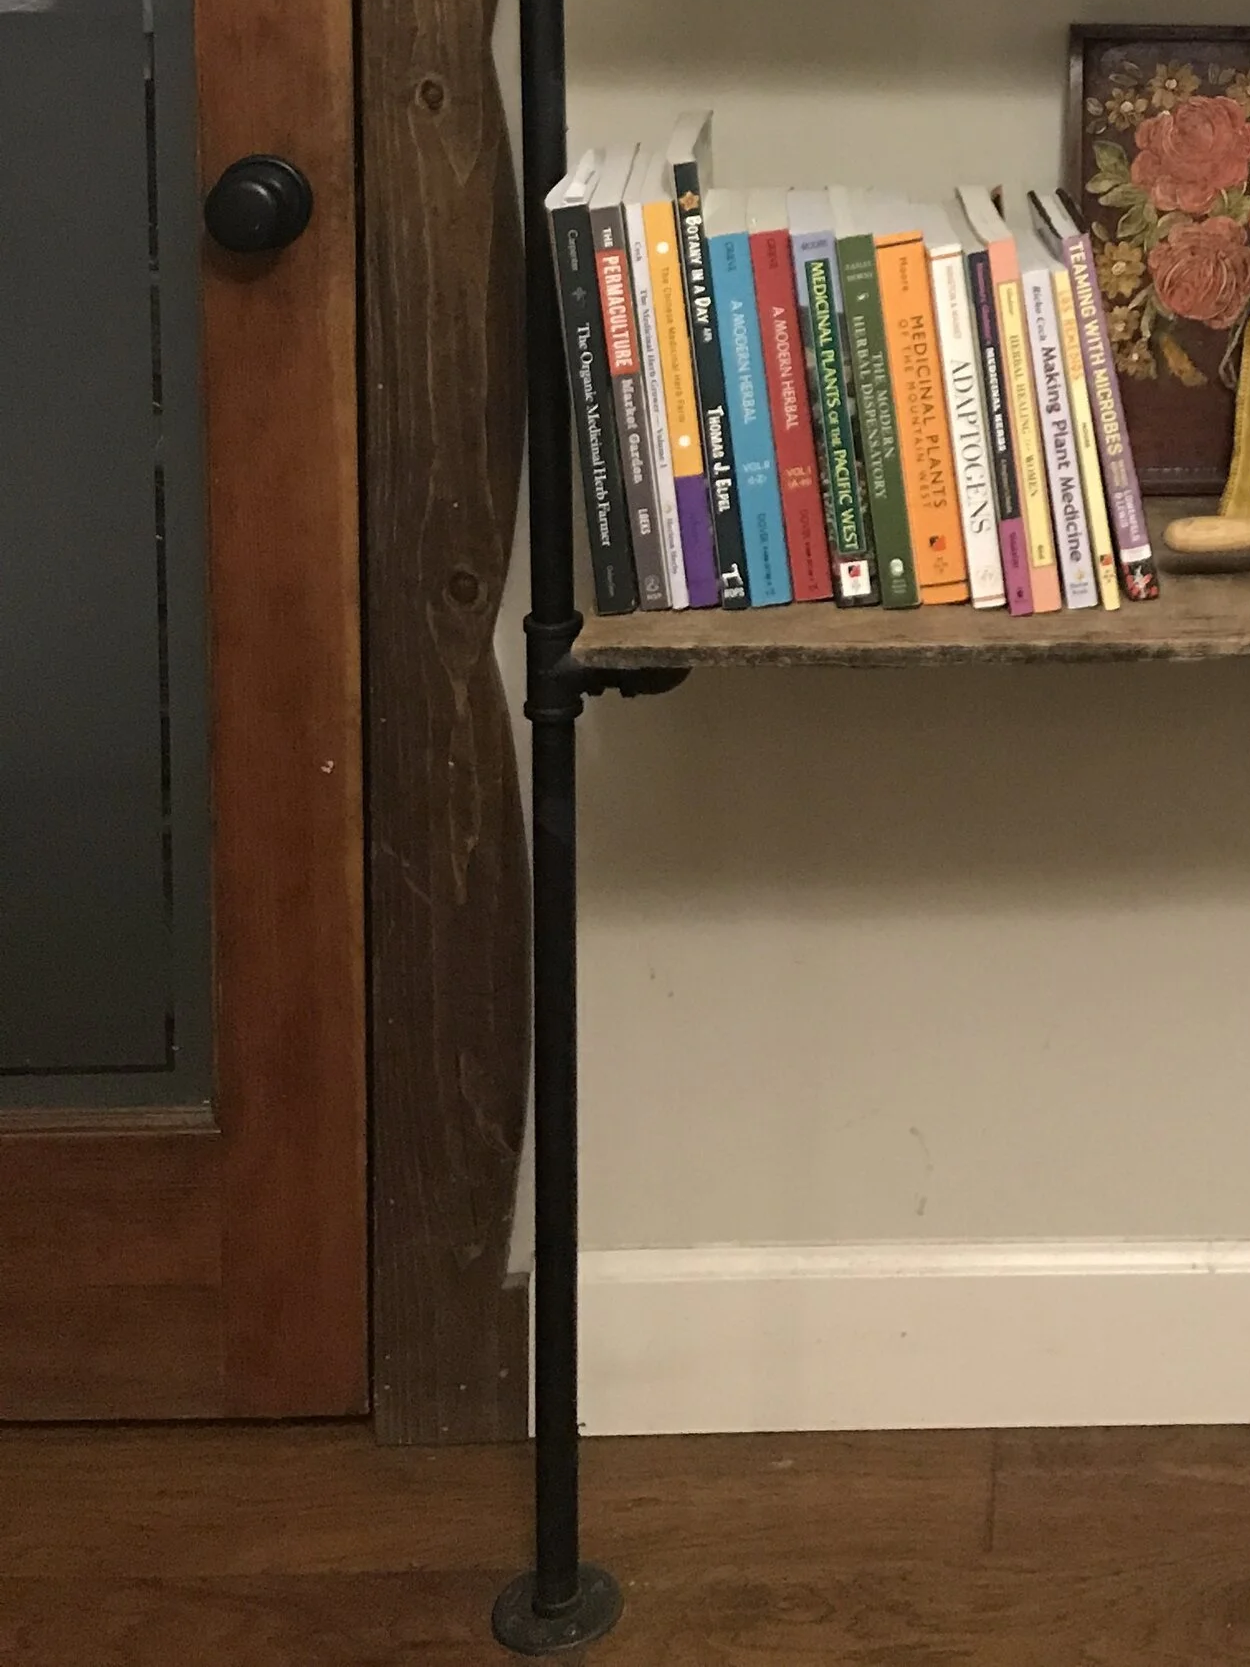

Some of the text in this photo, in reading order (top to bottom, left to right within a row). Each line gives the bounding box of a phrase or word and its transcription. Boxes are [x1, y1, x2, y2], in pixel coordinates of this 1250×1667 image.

[602, 228, 614, 248] THE
[685, 215, 703, 265] BOTANY
[691, 269, 704, 281] IN
[693, 285, 706, 294] A
[1069, 241, 1097, 318] TEAMING
[602, 255, 633, 368] PERMACULTURE
[694, 297, 712, 324] DAY
[810, 261, 833, 347] MEDICINAL
[577, 322, 591, 350] The
[730, 300, 757, 425] A MODERN HERBAL
[1010, 334, 1024, 381] HERBAL
[1083, 321, 1106, 366] WITH
[578, 351, 597, 403] Organic
[772, 306, 799, 431] A MODERN HERBAL
[820, 350, 842, 409] PLANTS
[1041, 346, 1061, 415] Making
[621, 378, 638, 430] Market
[853, 315, 888, 499] HERBAL DISPENSATORY
[872, 351, 896, 458] THE MODERN
[899, 319, 933, 509] OF THE MOUNTAIN WEST
[910, 315, 948, 509] MEDICINAL PLANTS
[985, 346, 1001, 413] MEDICINAL
[994, 413, 1007, 452] HERBS
[1015, 382, 1030, 436] HEALING
[1092, 367, 1124, 456] MICROBES
[586, 402, 606, 465] Medicinal
[628, 433, 643, 484] Garden
[707, 405, 725, 459] THOMAS
[830, 426, 842, 447] THE
[951, 360, 992, 535] ADAPTOGENS
[1052, 419, 1072, 471] Plant
[593, 465, 609, 502] Herb
[833, 449, 853, 505] PACIFIC
[1024, 454, 1039, 498] WOMEN
[596, 501, 611, 547] Farmer
[839, 509, 859, 550] WEST
[1059, 476, 1083, 564] Medicine
